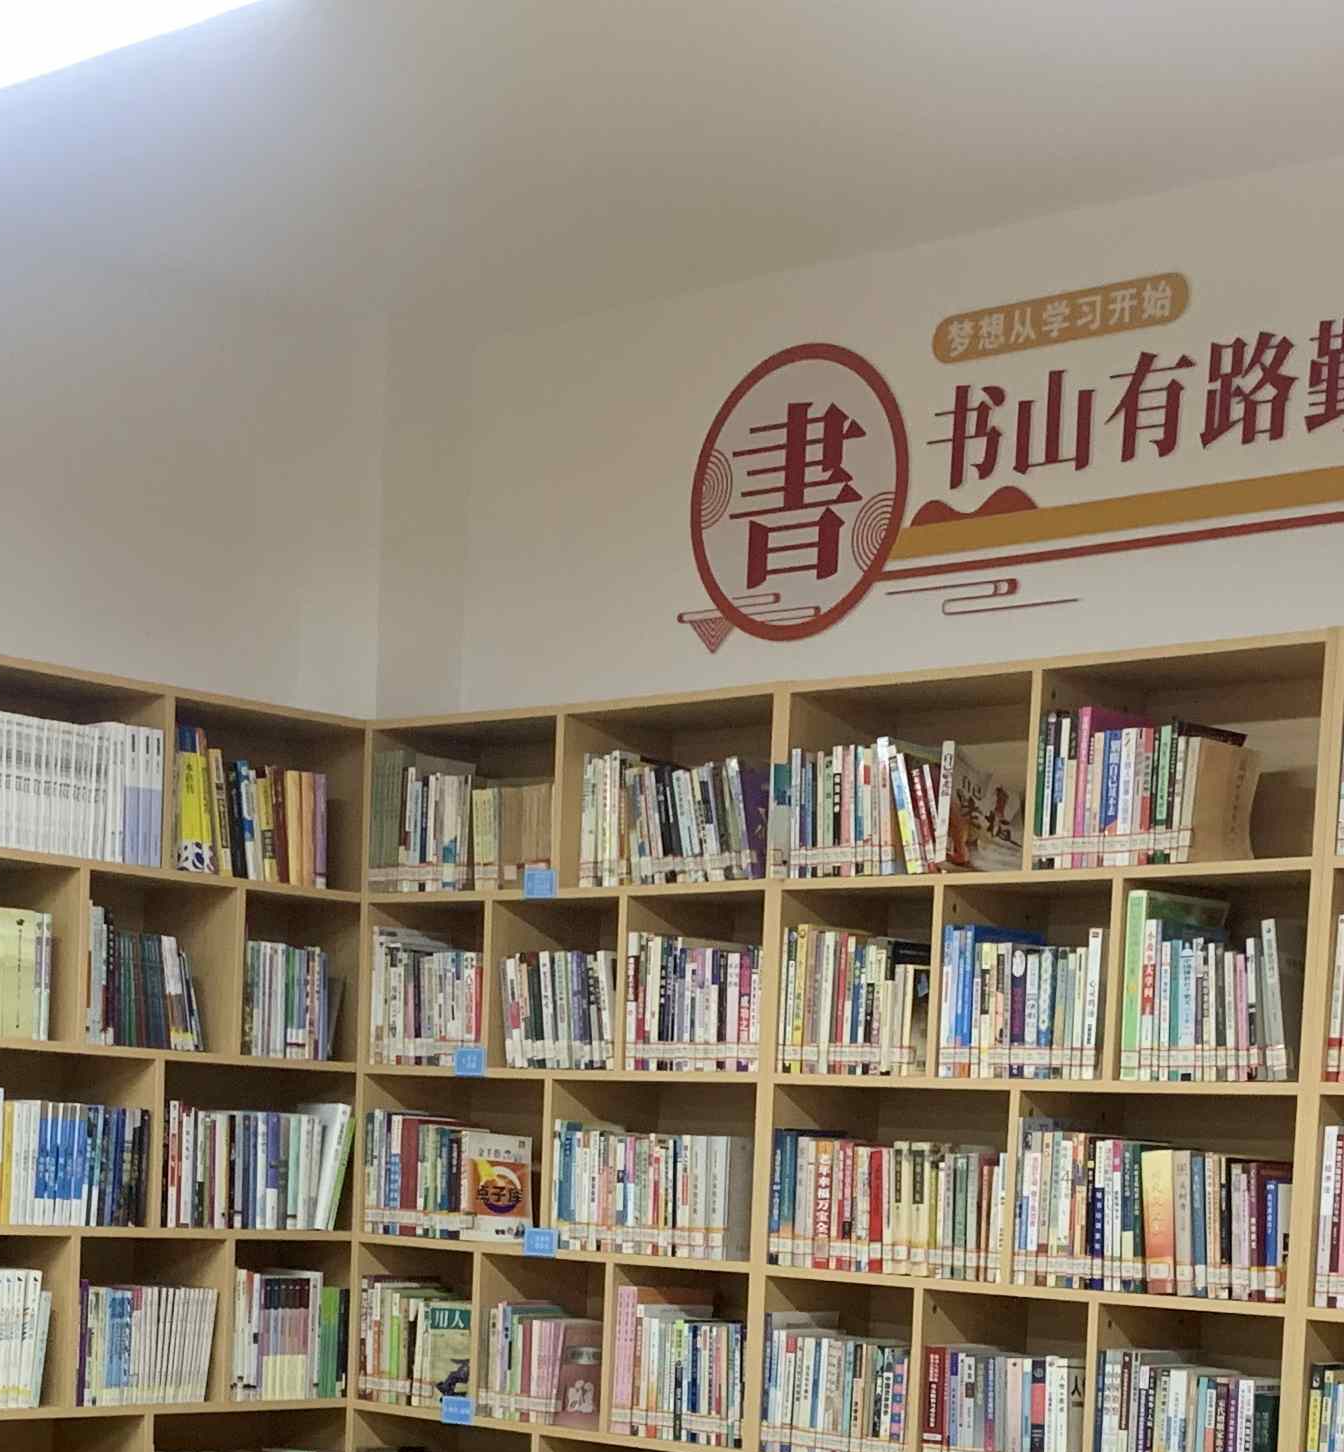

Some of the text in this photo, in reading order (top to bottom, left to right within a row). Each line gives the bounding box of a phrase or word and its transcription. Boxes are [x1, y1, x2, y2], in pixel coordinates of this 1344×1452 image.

[947, 280, 1172, 357] 梦想从学习开始
[729, 401, 867, 591] 書
